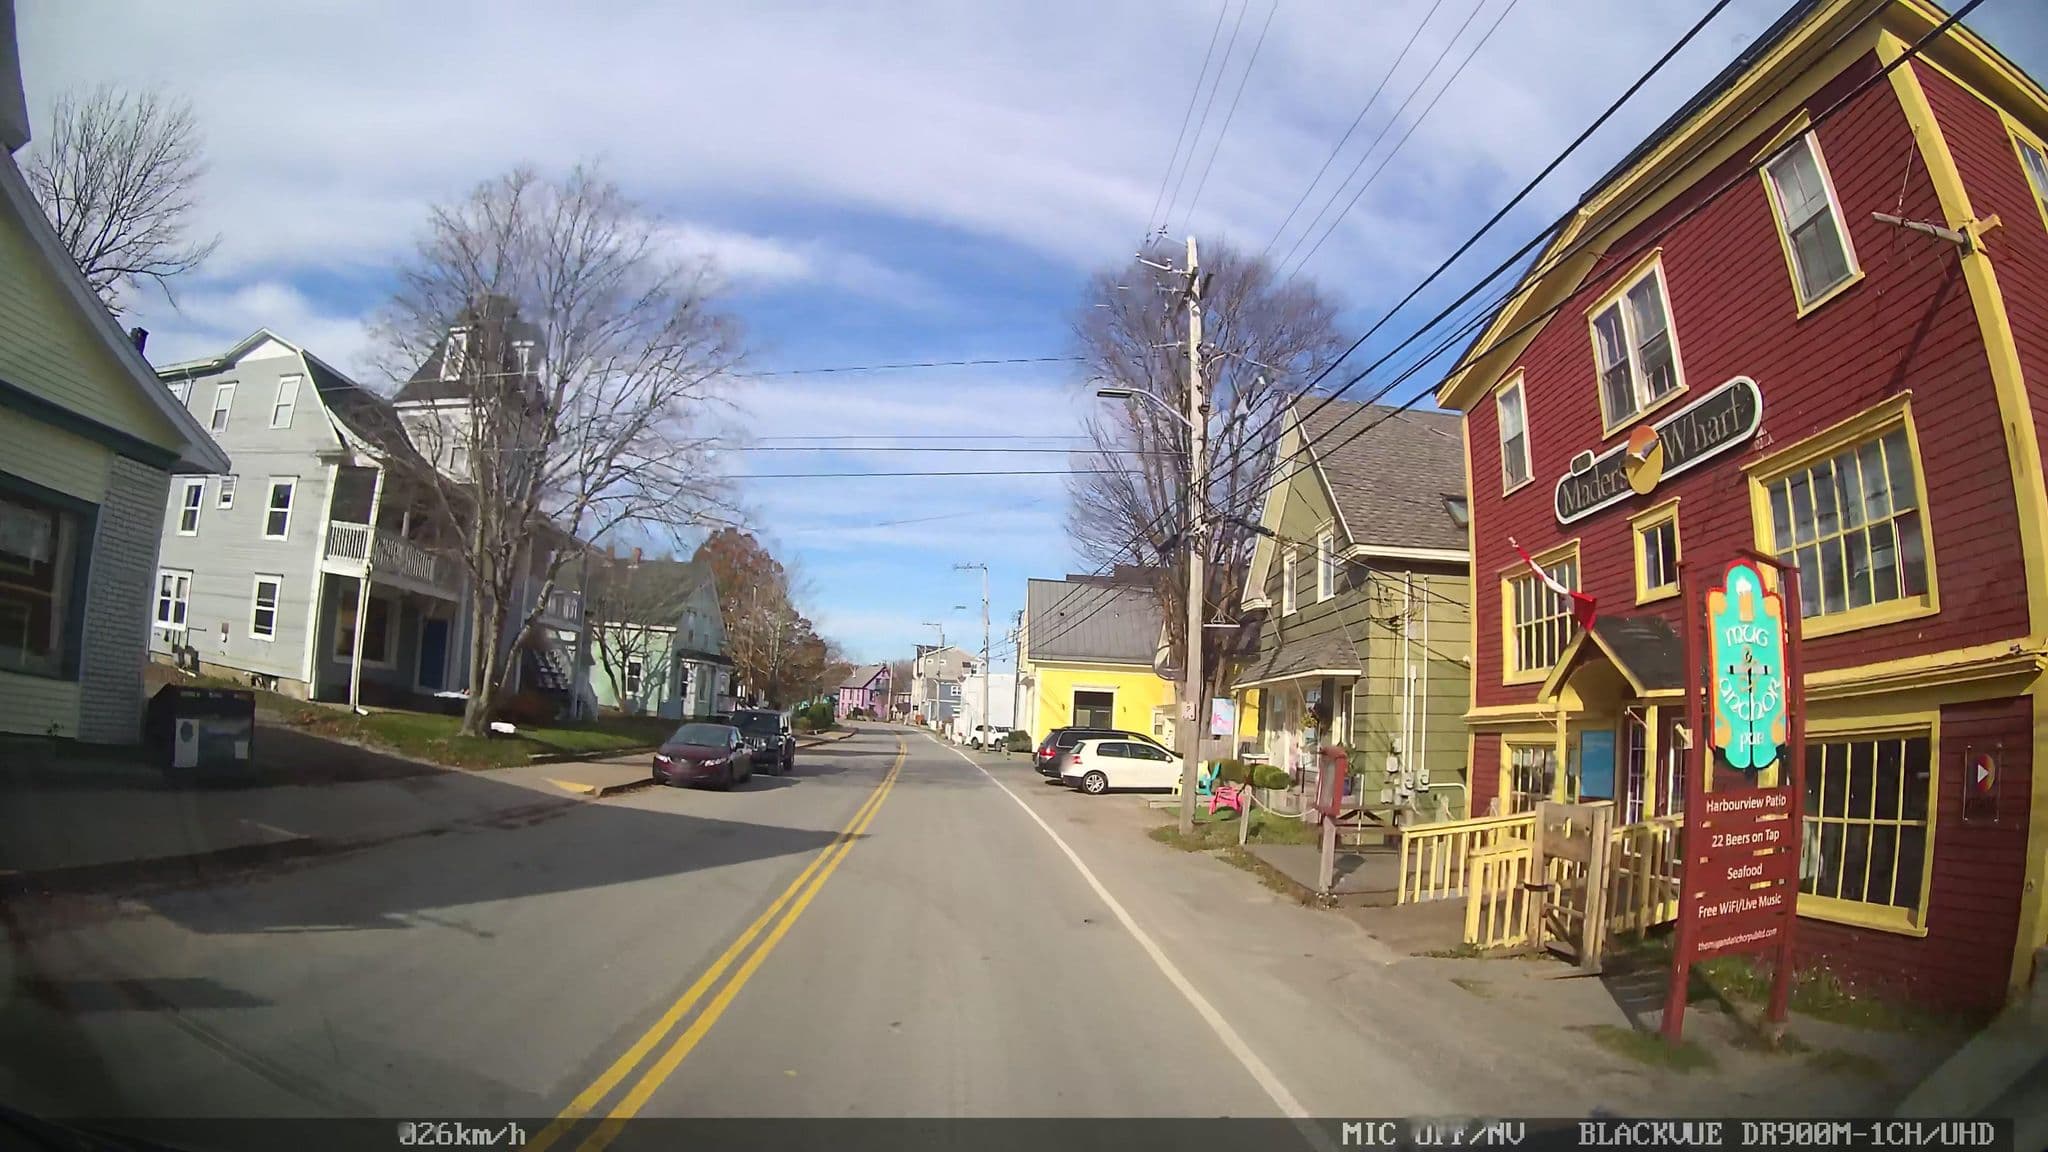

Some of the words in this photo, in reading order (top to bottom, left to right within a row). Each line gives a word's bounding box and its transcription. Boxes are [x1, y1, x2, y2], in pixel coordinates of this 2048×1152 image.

[1659, 383, 1742, 462] Wharf
[1706, 797, 1764, 813] Harbourview
[1765, 793, 1787, 808] Patio
[1711, 834, 1724, 848] 22
[1725, 832, 1751, 846] Beers
[1751, 832, 1764, 843] on
[1765, 828, 1780, 842] Tap
[1727, 862, 1763, 880] Seafood
[1698, 905, 1718, 918] Free
[1719, 897, 1758, 915] WiFi/Live
[1758, 893, 1782, 908] Music
